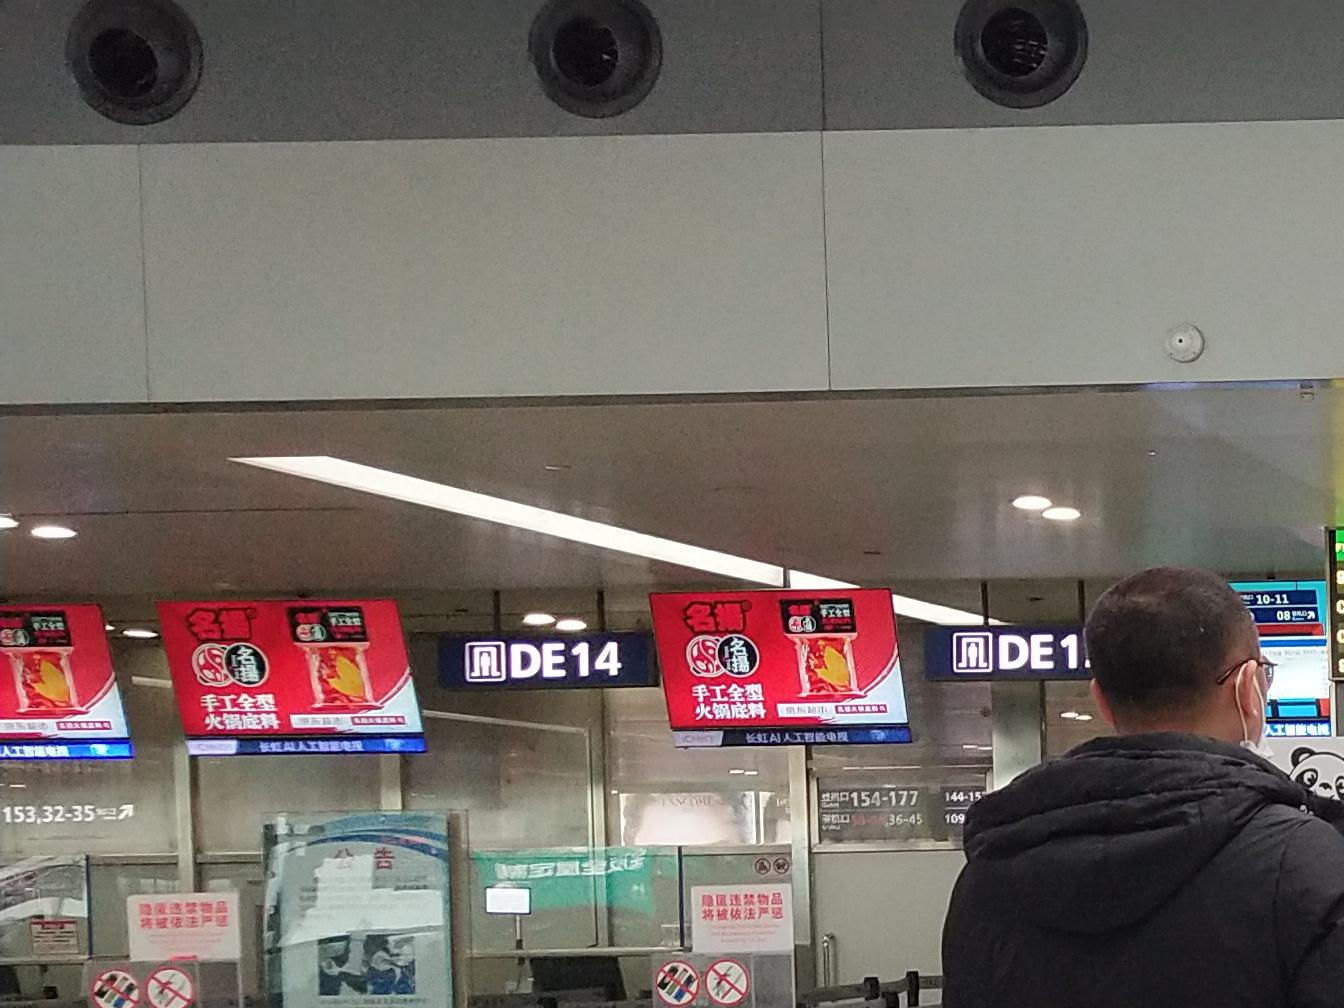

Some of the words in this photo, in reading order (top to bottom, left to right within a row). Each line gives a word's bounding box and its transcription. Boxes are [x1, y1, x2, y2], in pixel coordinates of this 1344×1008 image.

[1256, 594, 1290, 605] 10-11
[1276, 610, 1291, 621] 08
[510, 641, 622, 679] DE14
[998, 634, 1091, 671] DE1
[692, 684, 765, 702] 手工全型
[200, 693, 278, 712] 手工全型
[695, 702, 766, 721] 火锅底料
[204, 713, 281, 730] 火锅底料
[850, 790, 919, 808] 154-177
